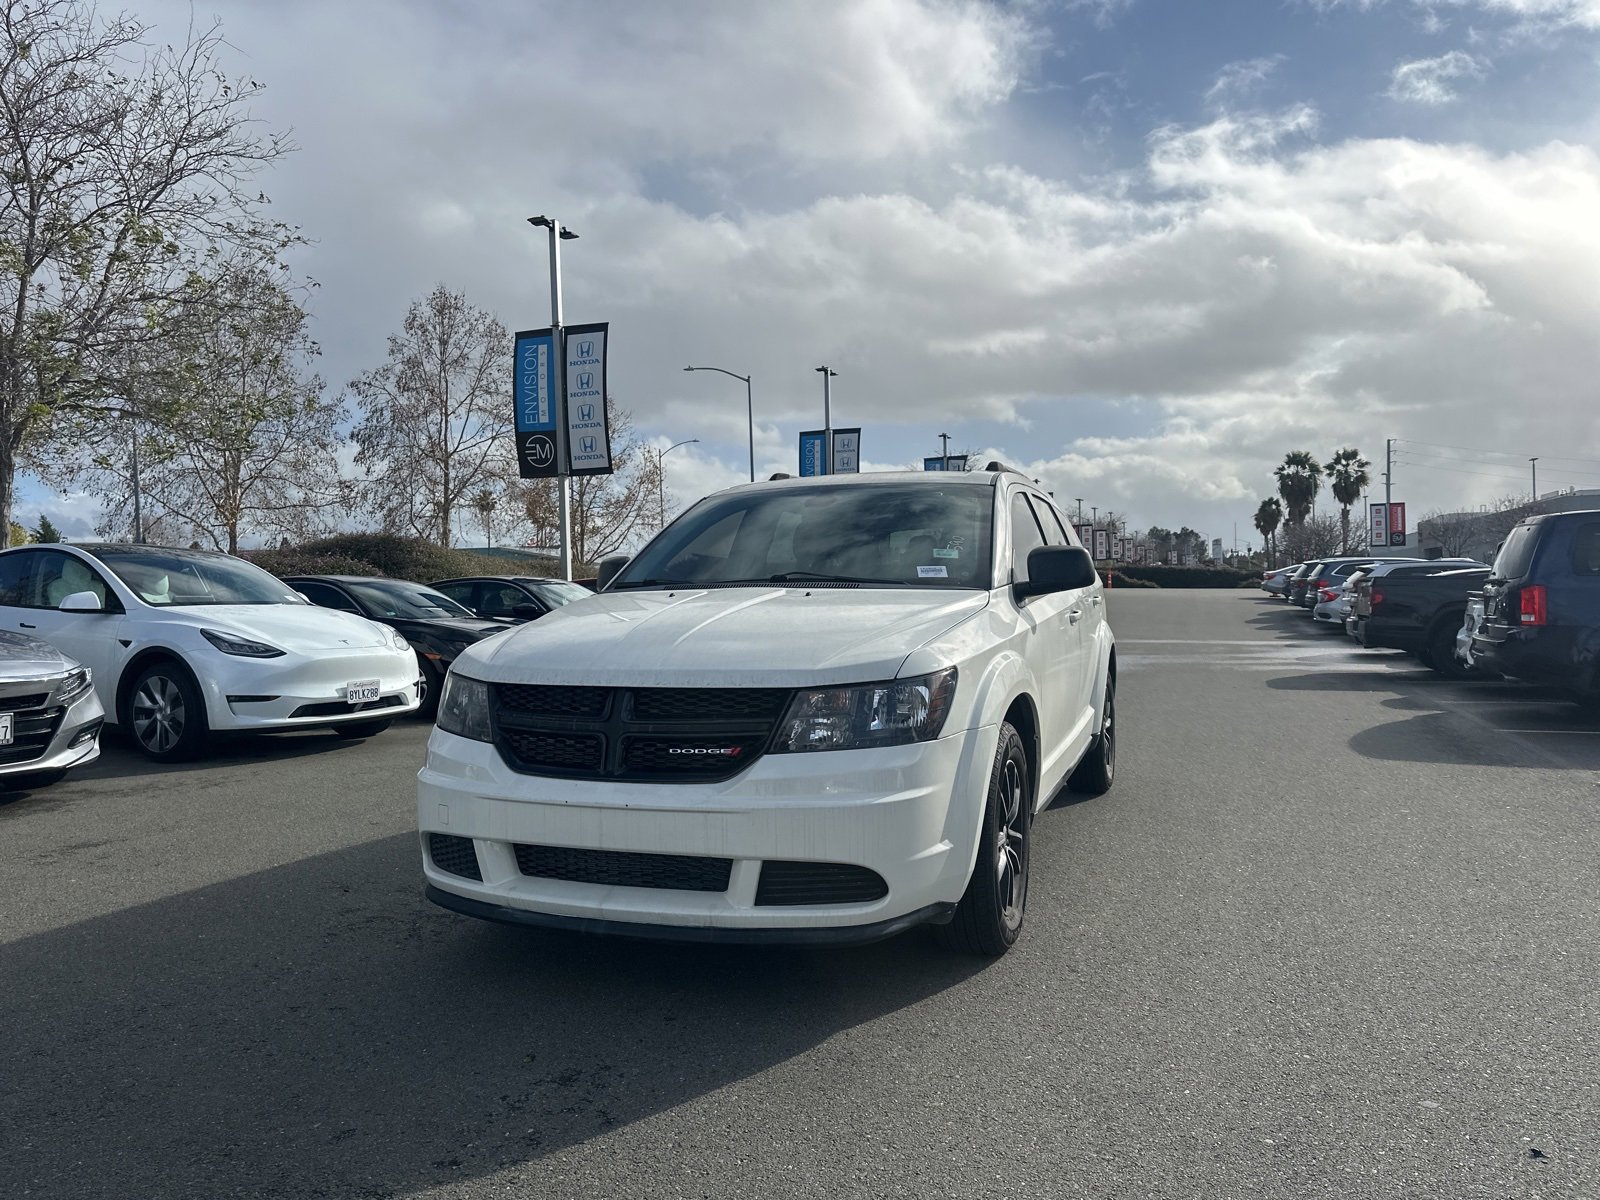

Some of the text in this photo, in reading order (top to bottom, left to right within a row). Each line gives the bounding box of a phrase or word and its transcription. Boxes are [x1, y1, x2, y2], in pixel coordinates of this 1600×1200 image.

[569, 358, 600, 366] HONDA
[524, 344, 538, 424] ENVISION
[573, 453, 605, 461] HONDA
[806, 439, 814, 476] VISION
